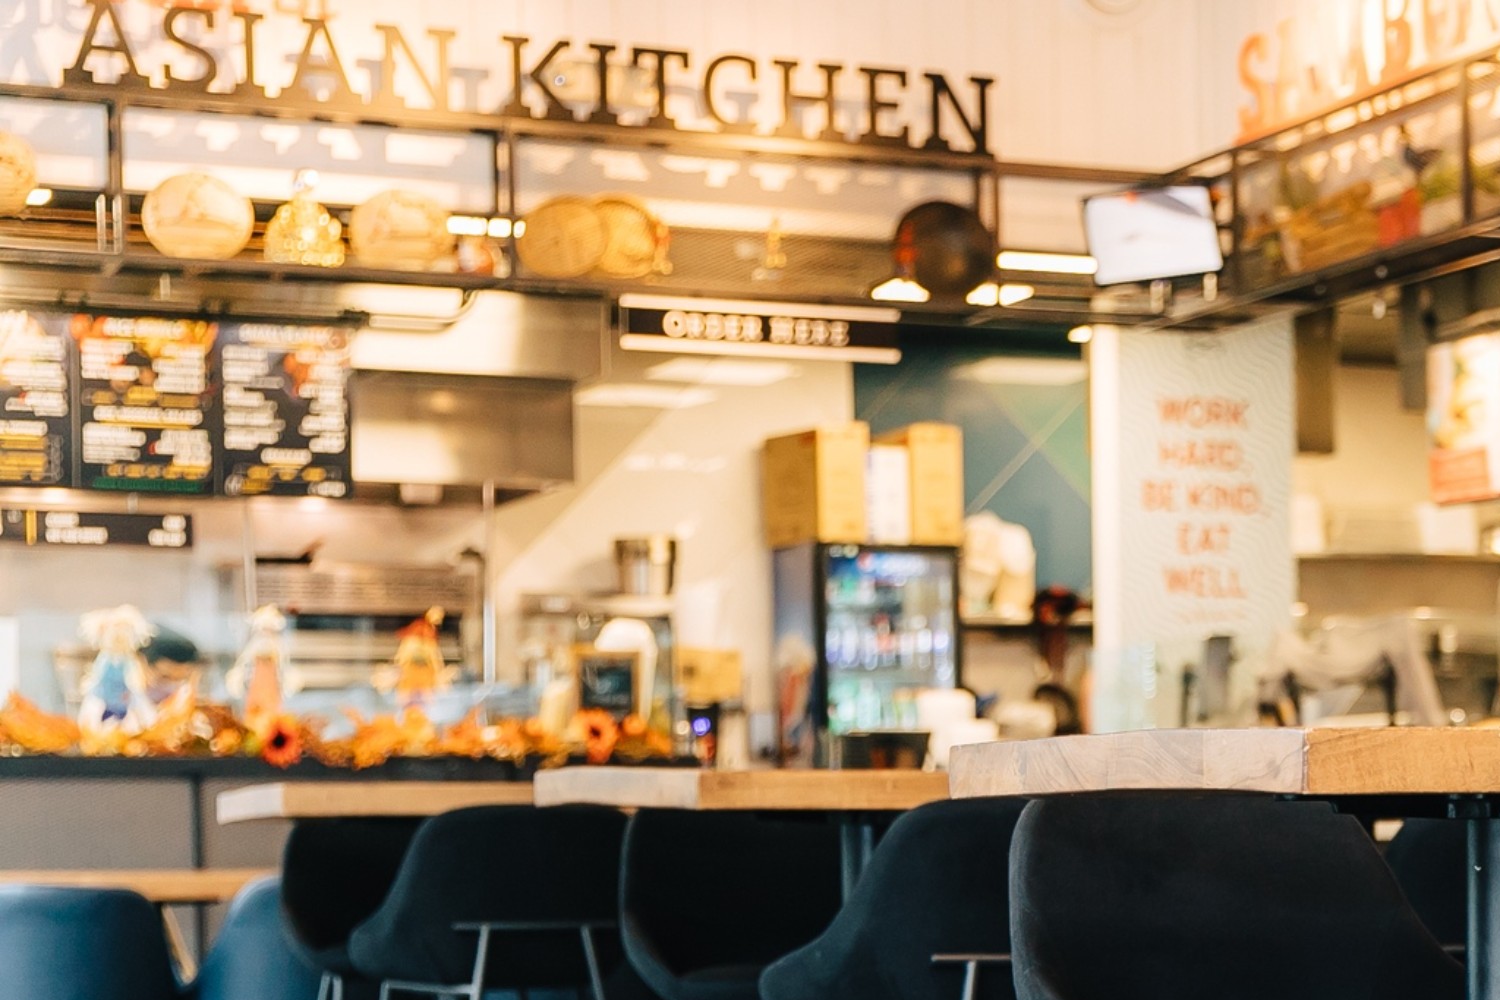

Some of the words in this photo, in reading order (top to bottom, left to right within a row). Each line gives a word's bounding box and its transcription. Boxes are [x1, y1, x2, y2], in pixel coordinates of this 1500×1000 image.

[62, 0, 456, 114] ASIAN
[502, 35, 995, 156] KITCHEN
[1156, 396, 1249, 428] WORK
[1176, 522, 1232, 555] EAT
[1162, 565, 1247, 599] WELL
